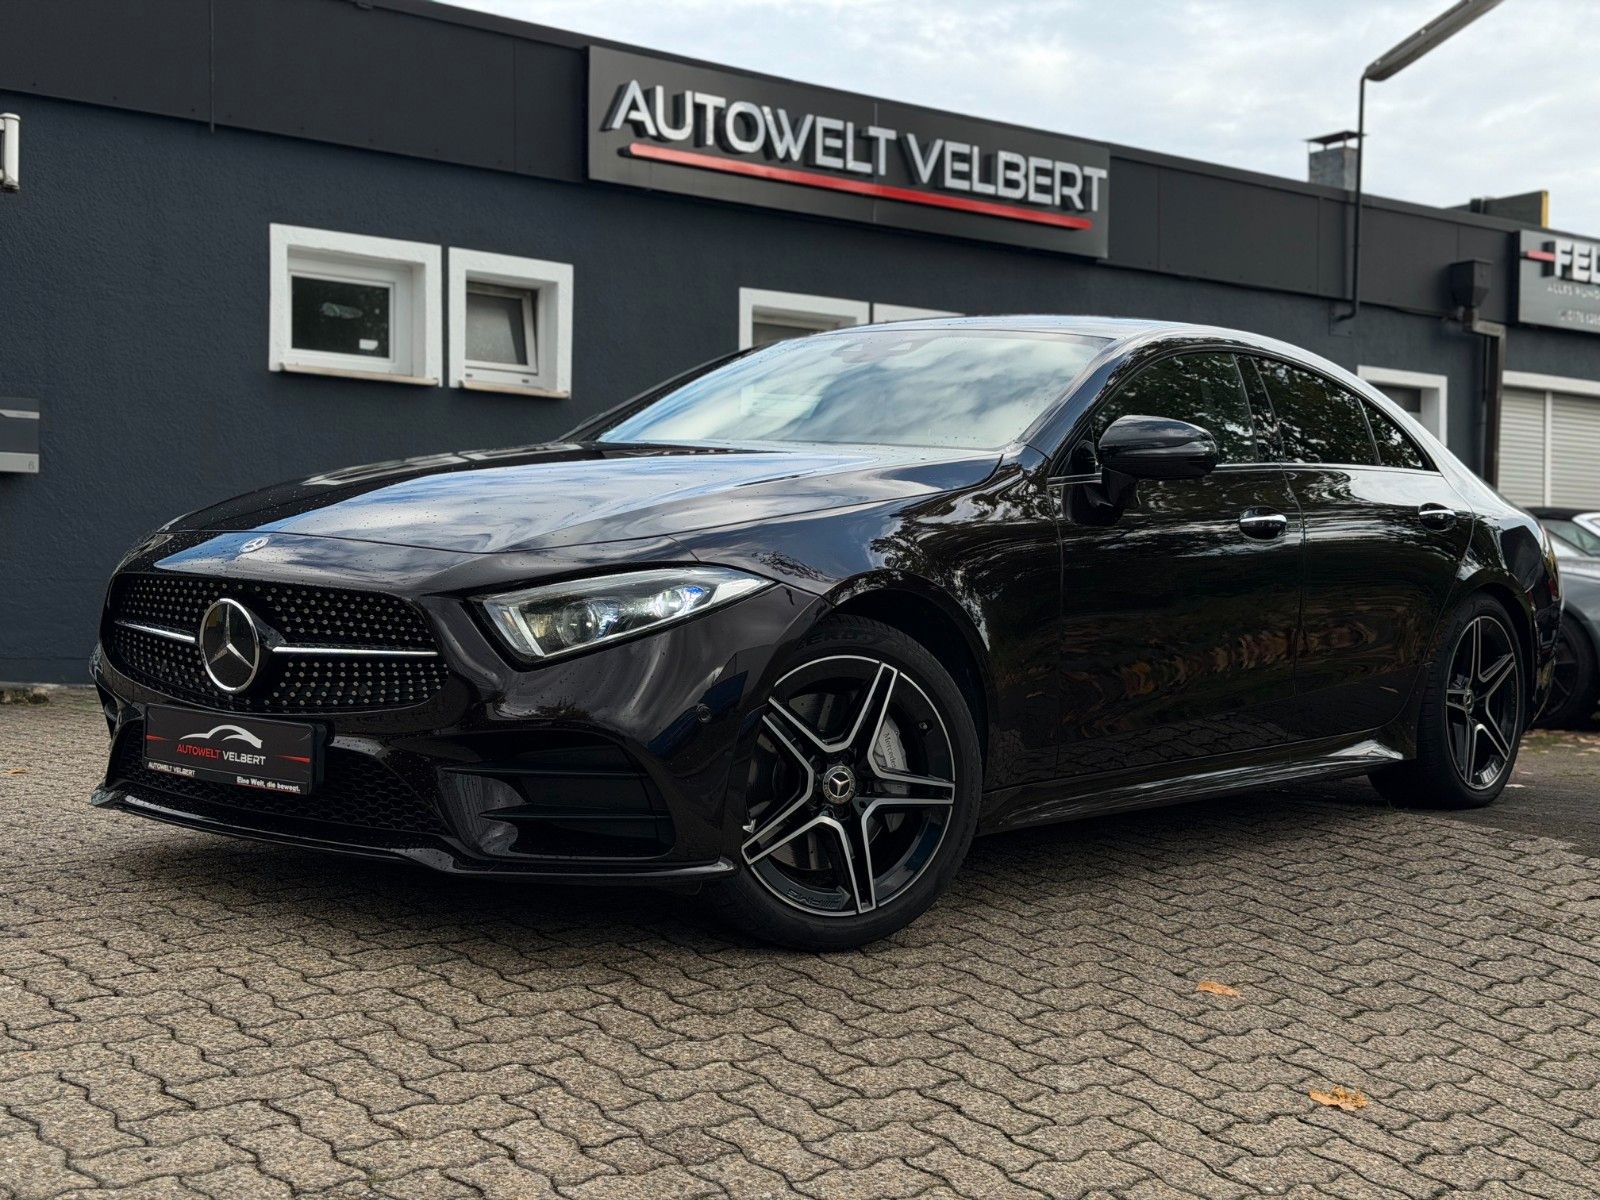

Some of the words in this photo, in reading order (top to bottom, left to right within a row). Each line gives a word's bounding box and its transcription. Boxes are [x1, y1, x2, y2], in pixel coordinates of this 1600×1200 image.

[605, 79, 897, 177] AUTOWELT
[907, 133, 1108, 212] VELBERT
[176, 744, 221, 760] AUTOWELT
[222, 750, 266, 766] VELBERT
[148, 761, 173, 772] AUTOWELT
[173, 766, 196, 778] VELBERT
[236, 775, 249, 785] Eine
[266, 780, 276, 789] die
